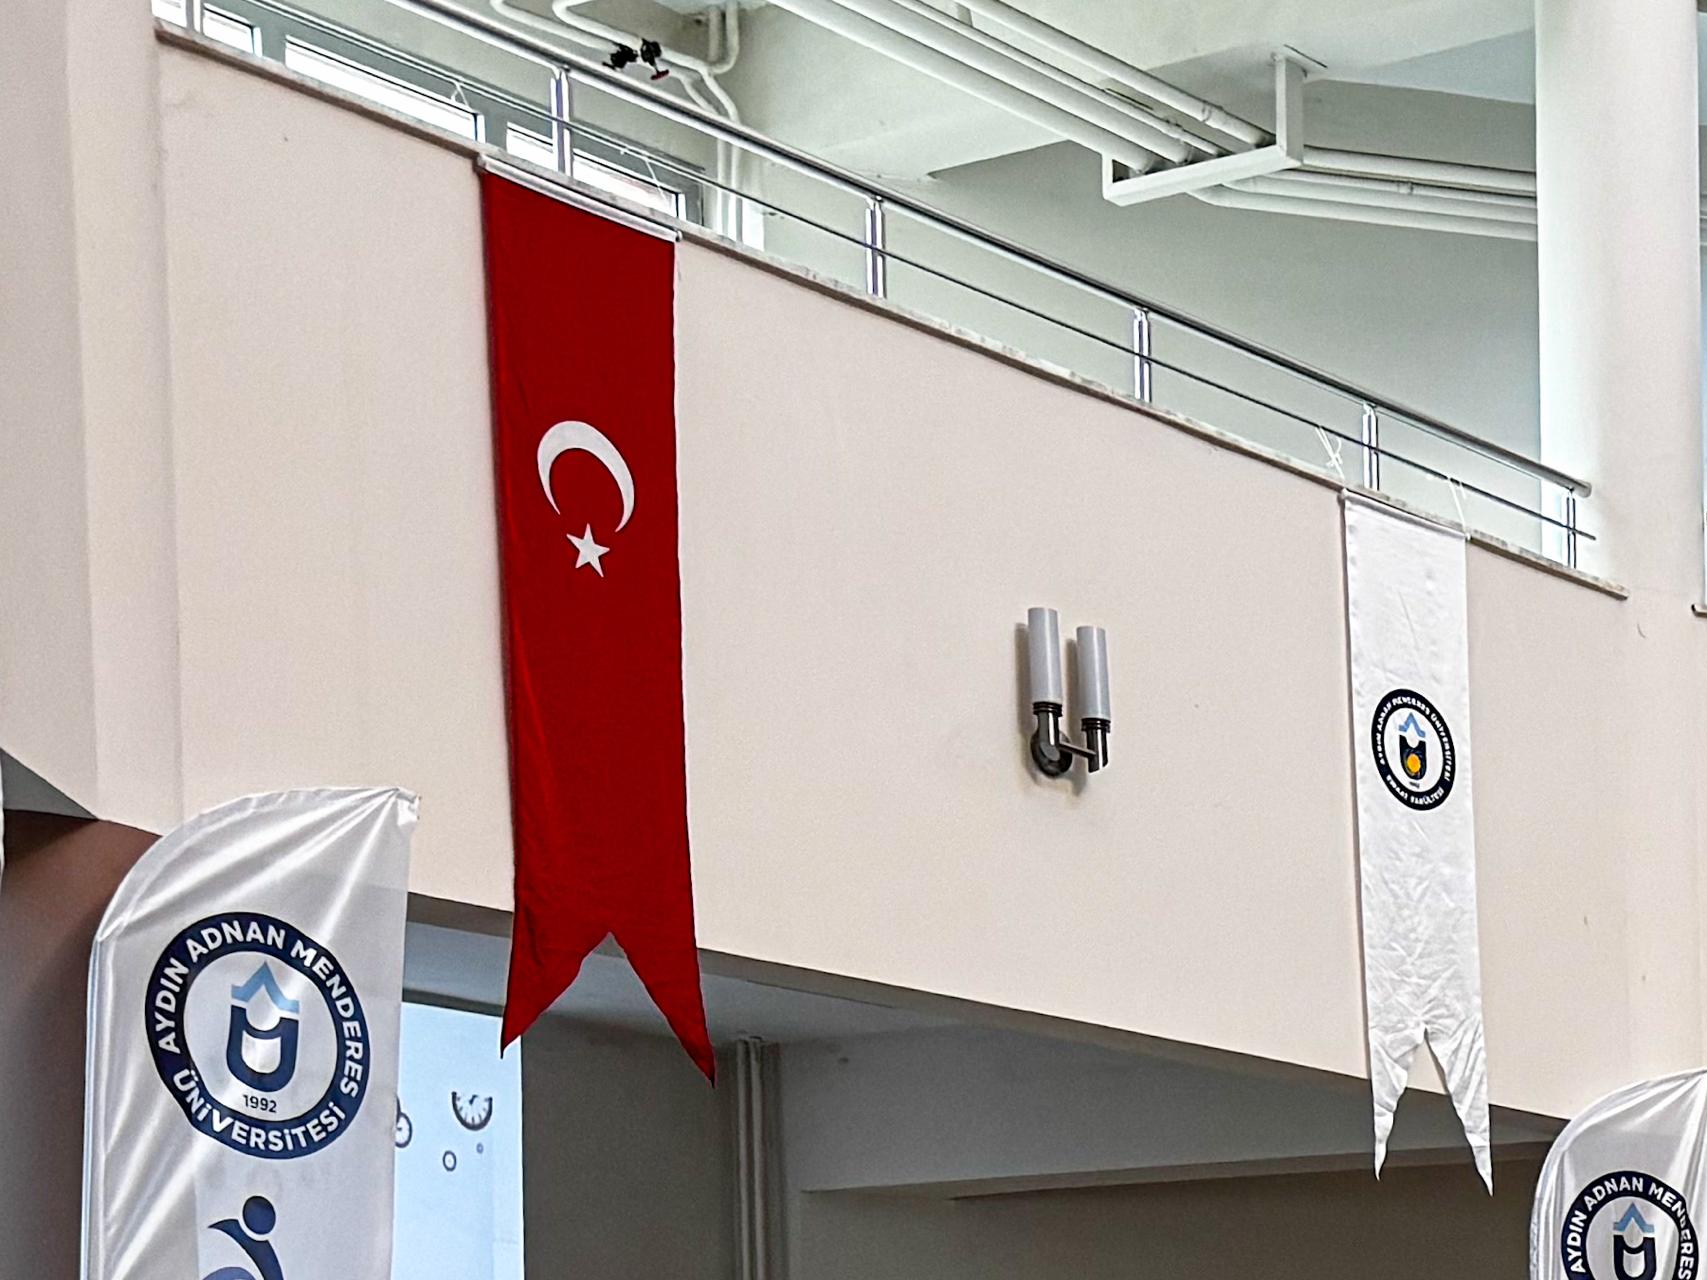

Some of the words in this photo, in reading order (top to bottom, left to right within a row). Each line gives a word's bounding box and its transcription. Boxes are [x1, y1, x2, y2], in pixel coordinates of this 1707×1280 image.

[155, 958, 190, 1054] AYDIN
[186, 920, 286, 963] ADNAN
[290, 940, 363, 1098] MENDERES
[173, 1068, 346, 1152] ÜNİVERSİTESİ
[242, 1094, 277, 1113] 1992
[1567, 1210, 1587, 1273] AYDIN
[1583, 1176, 1644, 1211] ADNAN
[1648, 1182, 1695, 1280] MENDERES
